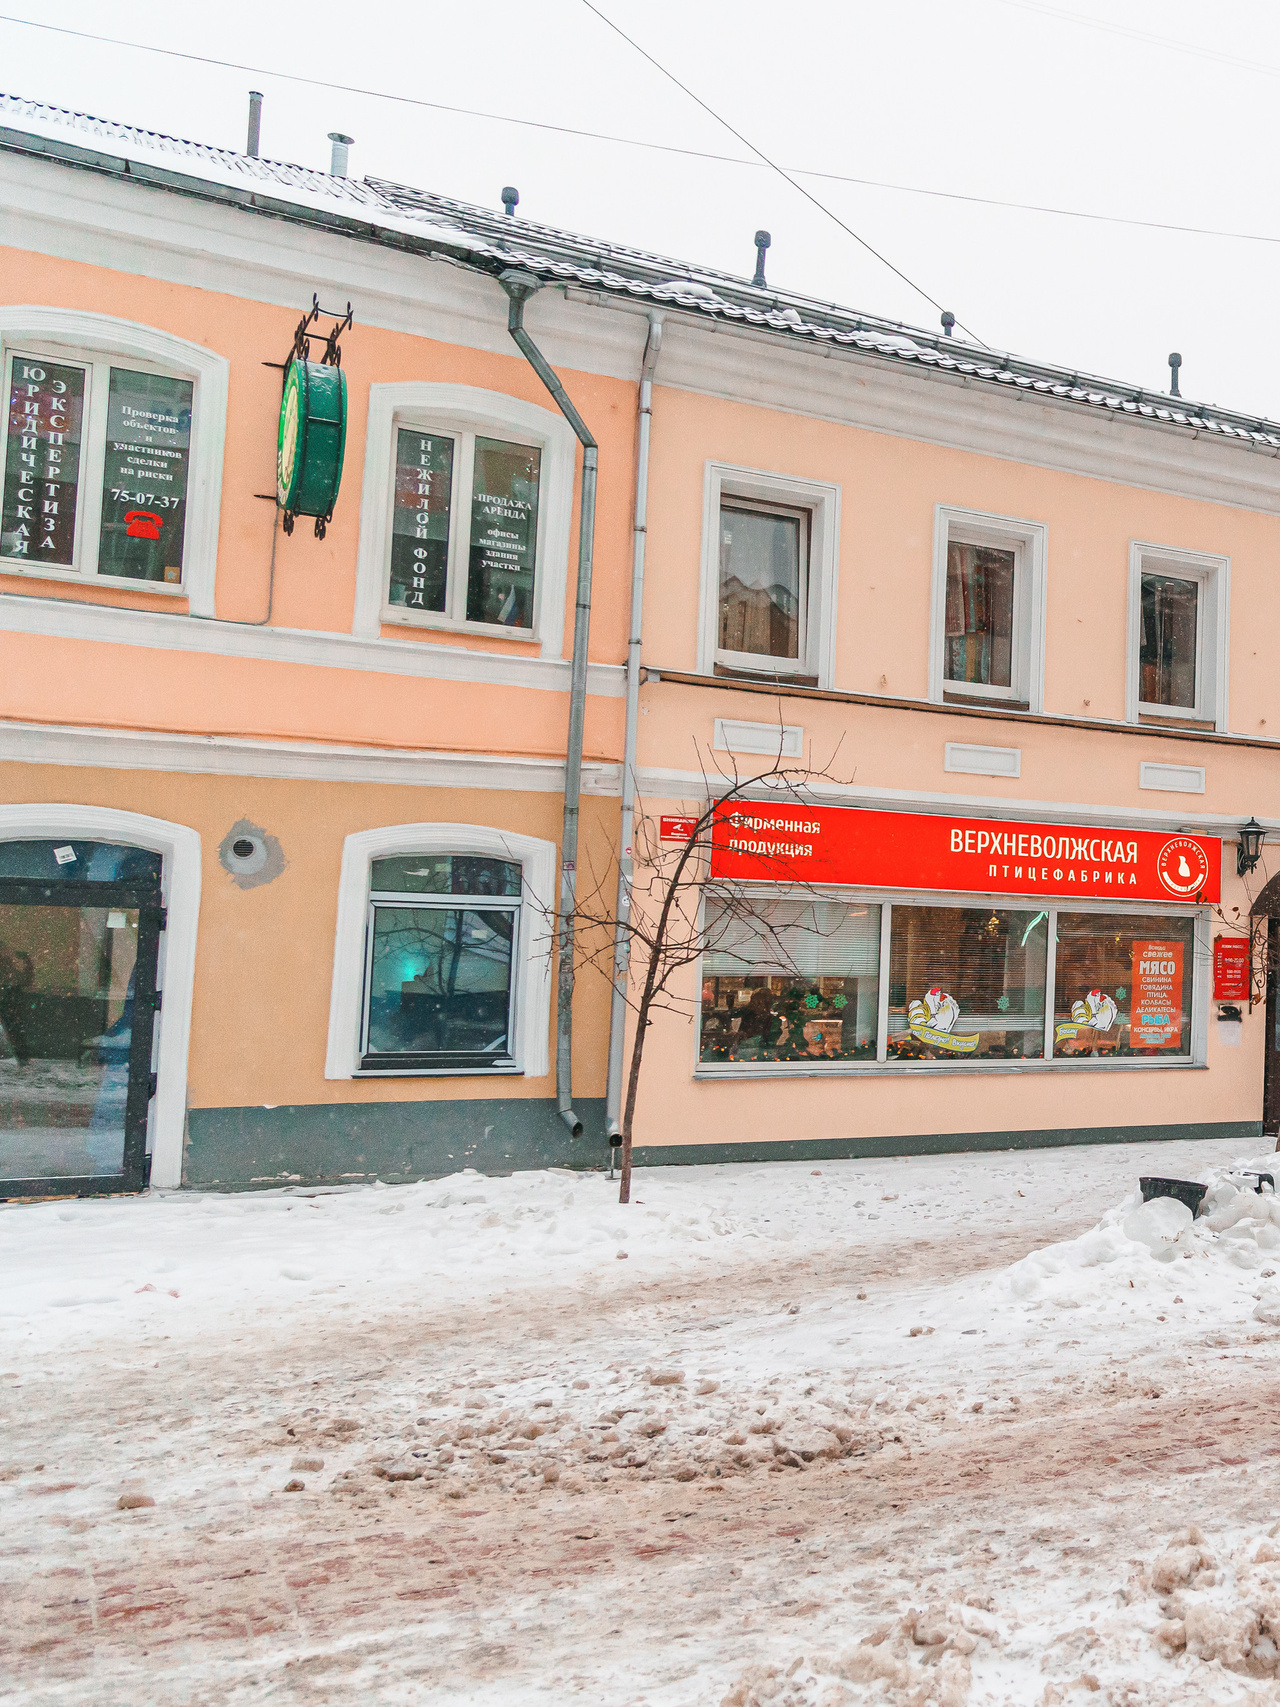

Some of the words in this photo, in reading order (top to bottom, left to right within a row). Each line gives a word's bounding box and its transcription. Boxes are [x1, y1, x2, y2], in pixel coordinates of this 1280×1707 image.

[122, 405, 179, 423] Проверка
[123, 419, 176, 434] объектов
[15, 365, 46, 554] ЮРИДИЧЕСКАЯ
[113, 442, 182, 459] участников
[41, 380, 67, 549] ЭКСПЕРТИЗА
[127, 456, 168, 469] сделки
[120, 467, 134, 475] на
[138, 469, 173, 481] риски
[111, 488, 180, 509] 75-07-37
[416, 439, 434, 540] НЕЖИЛОЙ
[478, 493, 532, 511] ПРОДАЖА
[482, 506, 526, 520] АРЕНДА
[487, 529, 519, 539] офисы
[479, 538, 526, 551] магазины
[485, 550, 518, 561] здания
[481, 559, 521, 571] участки
[411, 547, 428, 606] ФОНД
[729, 811, 821, 834] Фирменная
[729, 838, 813, 859] продукция
[950, 828, 1138, 864] ВЕРХНЕВОЛЖСКАЯ
[1160, 840, 1206, 869] ВЕРХНЕВОЛЖСКАЯ
[988, 864, 1138, 885] ПТИЦЕФАБРИКА
[1139, 960, 1176, 975] МЯСО
[1141, 1014, 1170, 1025] РЫБА
